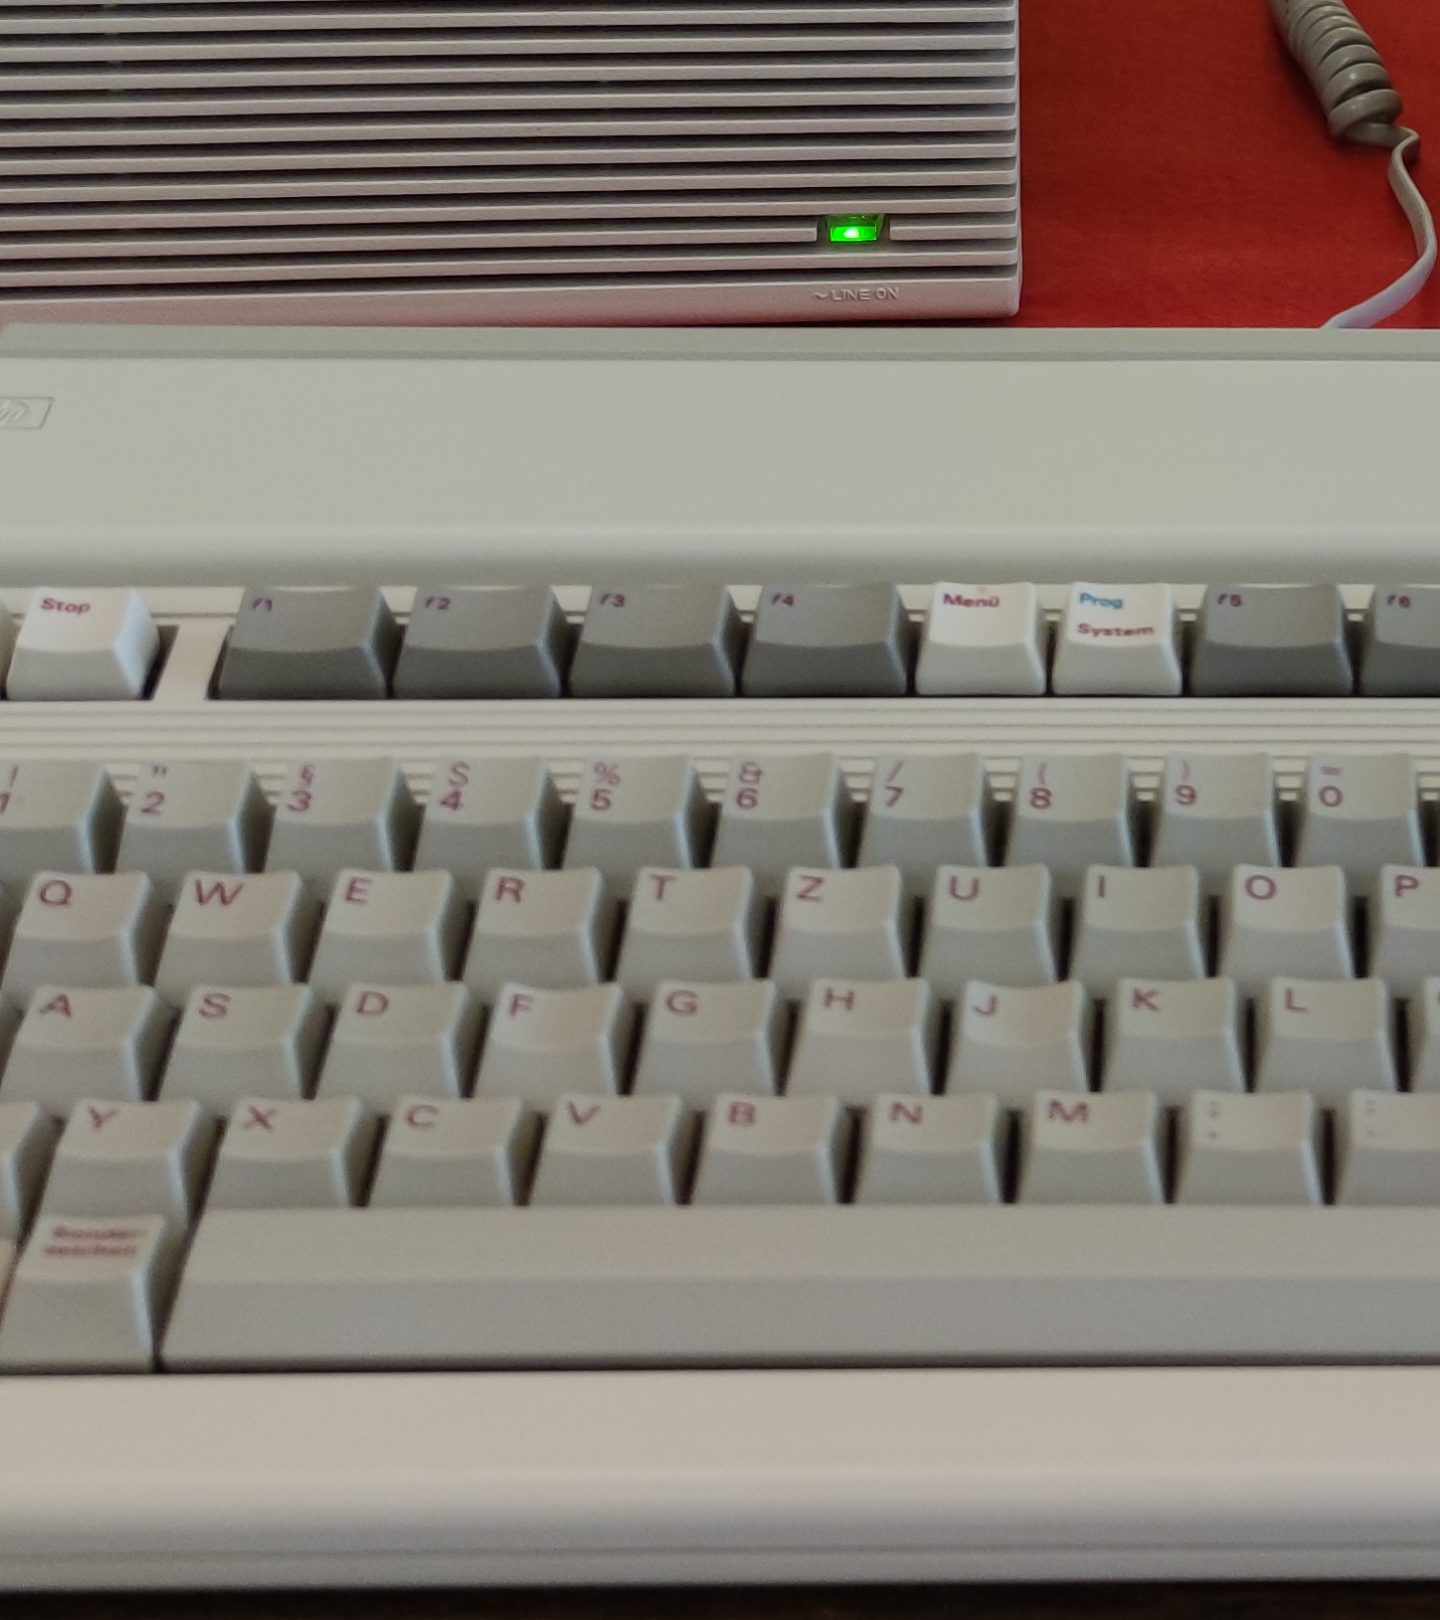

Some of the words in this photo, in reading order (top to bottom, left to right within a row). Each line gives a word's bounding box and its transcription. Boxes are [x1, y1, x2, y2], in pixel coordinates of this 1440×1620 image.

[832, 288, 871, 301] LINE
[876, 286, 899, 300] ON
[40, 596, 91, 616] Stop
[942, 592, 1000, 609] Menü
[1079, 592, 1124, 610] Prog
[1077, 622, 1155, 639] System
[39, 879, 73, 907] Q
[194, 879, 244, 907] W
[345, 877, 372, 905] E
[494, 876, 525, 904] R
[650, 875, 677, 901] T
[796, 875, 824, 903] Z
[949, 875, 980, 901] U
[1245, 874, 1277, 900] O
[1395, 874, 1420, 897] P
[40, 994, 73, 1020] A
[198, 993, 232, 1020] S
[356, 991, 389, 1017] D
[508, 993, 534, 1016] F
[666, 990, 699, 1016] G
[822, 987, 857, 1010] H
[973, 994, 997, 1017] J
[1131, 987, 1159, 1011] K
[1284, 987, 1309, 1013] L
[87, 1105, 119, 1131] Y
[241, 1104, 277, 1132] X
[405, 1103, 440, 1128] C
[567, 1101, 600, 1126] V
[728, 1100, 757, 1127] B
[889, 1100, 924, 1125] N
[1047, 1099, 1090, 1124] M
